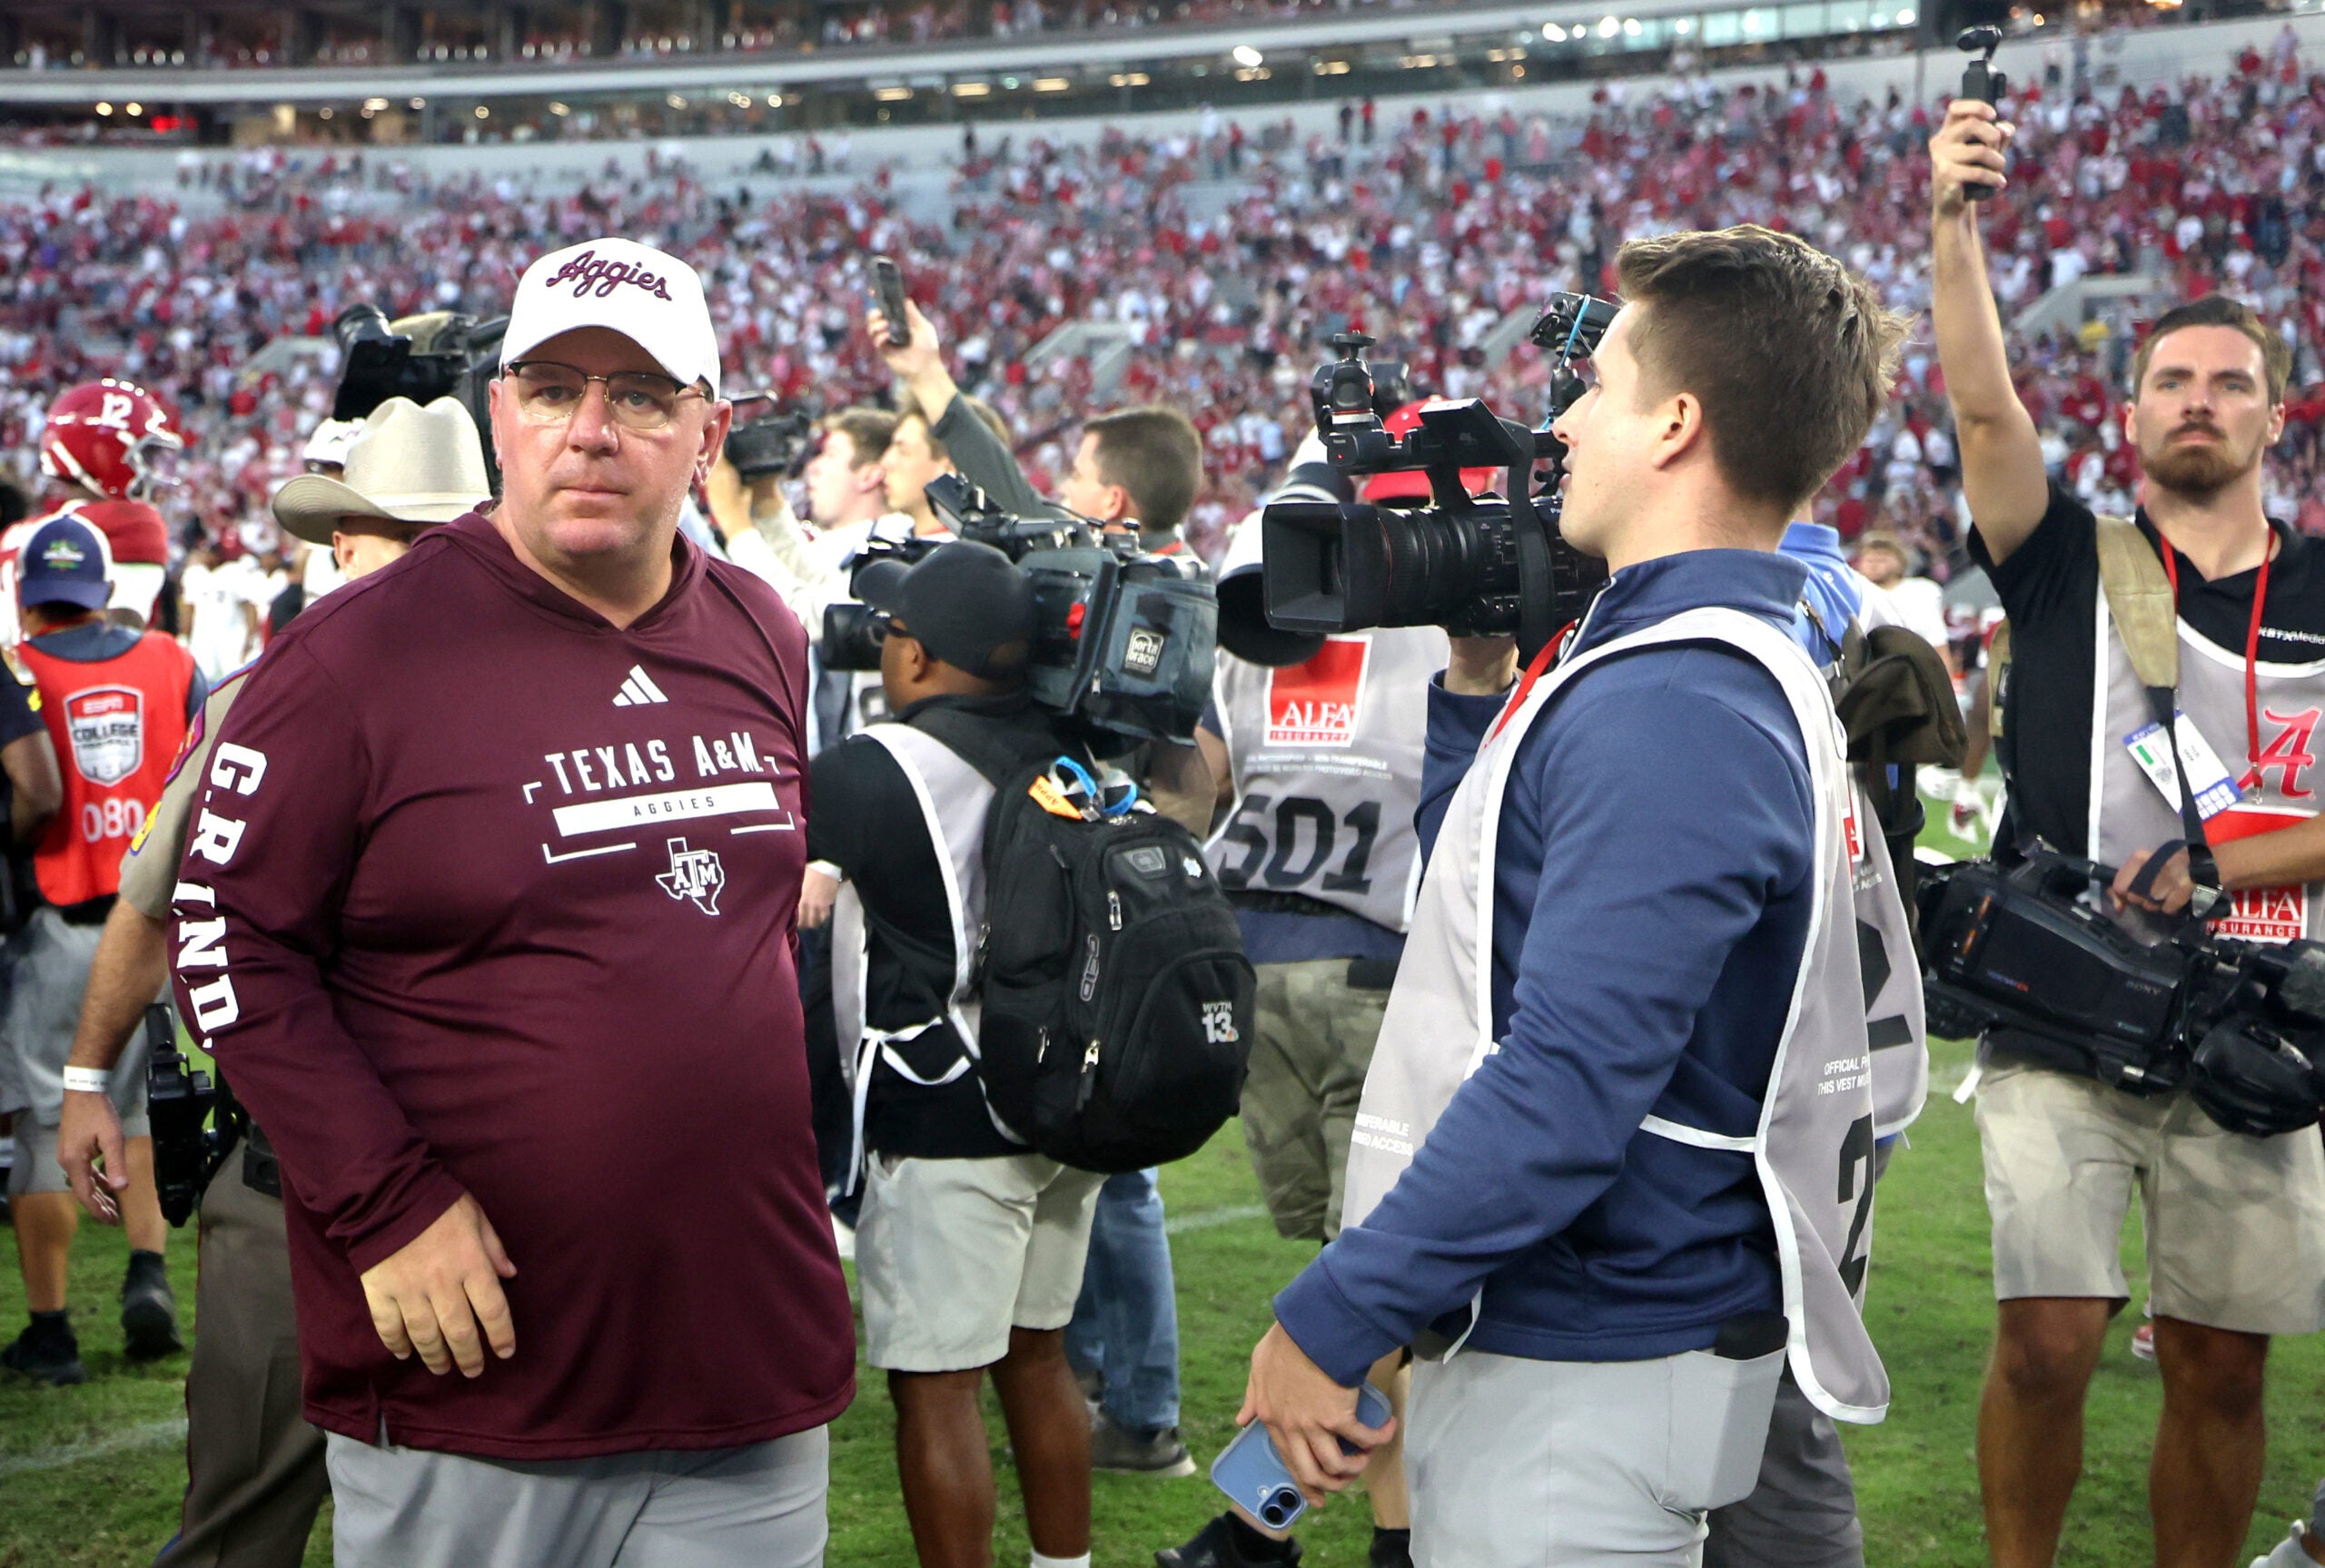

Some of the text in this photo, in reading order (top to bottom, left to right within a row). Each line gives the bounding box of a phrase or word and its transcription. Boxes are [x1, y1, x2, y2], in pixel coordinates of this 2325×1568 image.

[546, 250, 672, 301] Aggies
[101, 392, 134, 429] 12
[1279, 700, 1354, 727] ALFA
[74, 724, 138, 743] COLLEGE
[545, 739, 675, 794] TEXAS
[634, 796, 714, 816] AGGIES
[83, 797, 145, 843] 080
[1218, 794, 1381, 896] 501
[2206, 921, 2297, 938] NSURANCE
[1202, 1001, 1232, 1013] WVTM
[1202, 1011, 1236, 1043] 13
[1824, 1058, 1859, 1075] OFFICIAL
[1817, 1080, 1835, 1096] THIS
[1835, 1076, 1856, 1092] VEST
